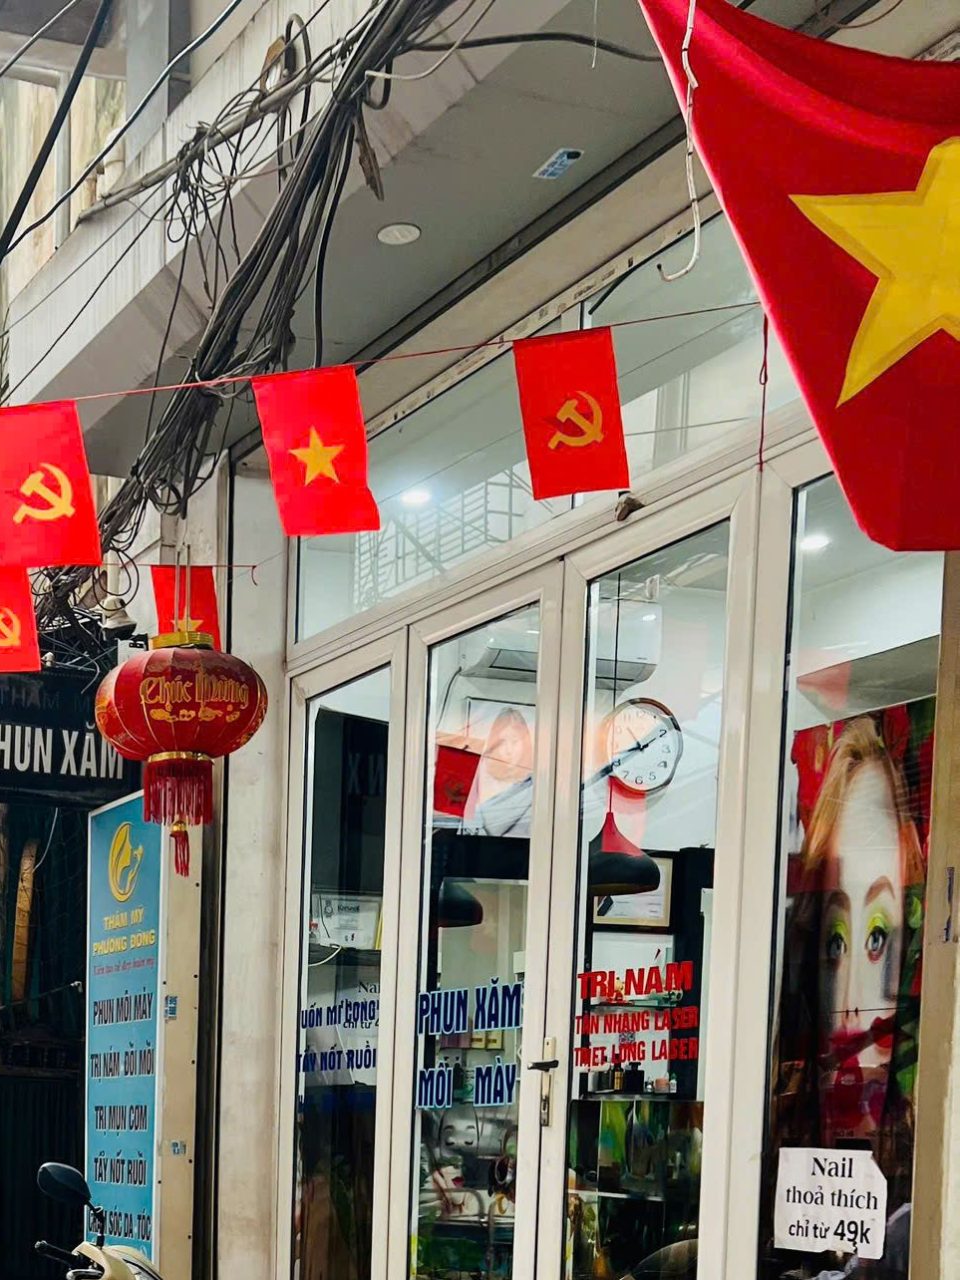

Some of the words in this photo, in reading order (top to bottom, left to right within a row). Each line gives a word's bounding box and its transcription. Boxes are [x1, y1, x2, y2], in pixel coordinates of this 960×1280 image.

[624, 948, 693, 996] NÁM
[93, 999, 114, 1026] PHUN
[417, 986, 469, 1035] PHUN
[473, 977, 523, 1031] XĂM
[603, 1010, 650, 1034] NHANG
[654, 1006, 698, 1031] LASER
[652, 1037, 699, 1062] LASER
[417, 1061, 454, 1108] MÔI
[473, 1056, 517, 1106] MÀY
[811, 1157, 854, 1179] Nail
[786, 1185, 825, 1206] thoả
[830, 1188, 878, 1210] thích
[788, 1219, 810, 1237] chỉ
[813, 1222, 830, 1239] từ
[833, 1219, 871, 1245] 49k
